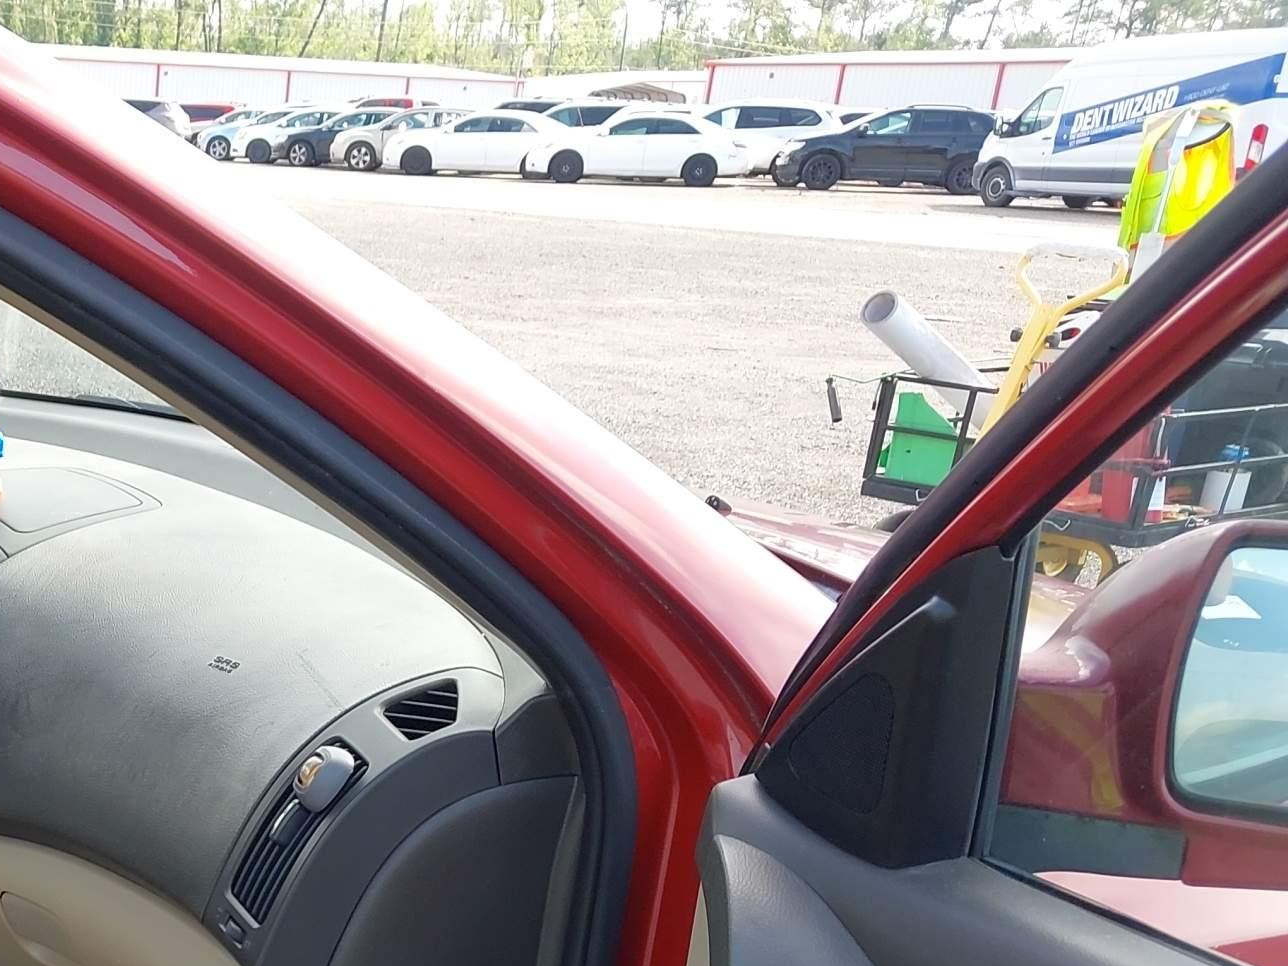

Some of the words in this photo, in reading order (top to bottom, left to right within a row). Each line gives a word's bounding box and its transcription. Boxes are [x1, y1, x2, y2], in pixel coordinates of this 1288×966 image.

[1070, 103, 1114, 135] DENT
[1112, 85, 1180, 125] WIZARD
[213, 656, 240, 669] SRS
